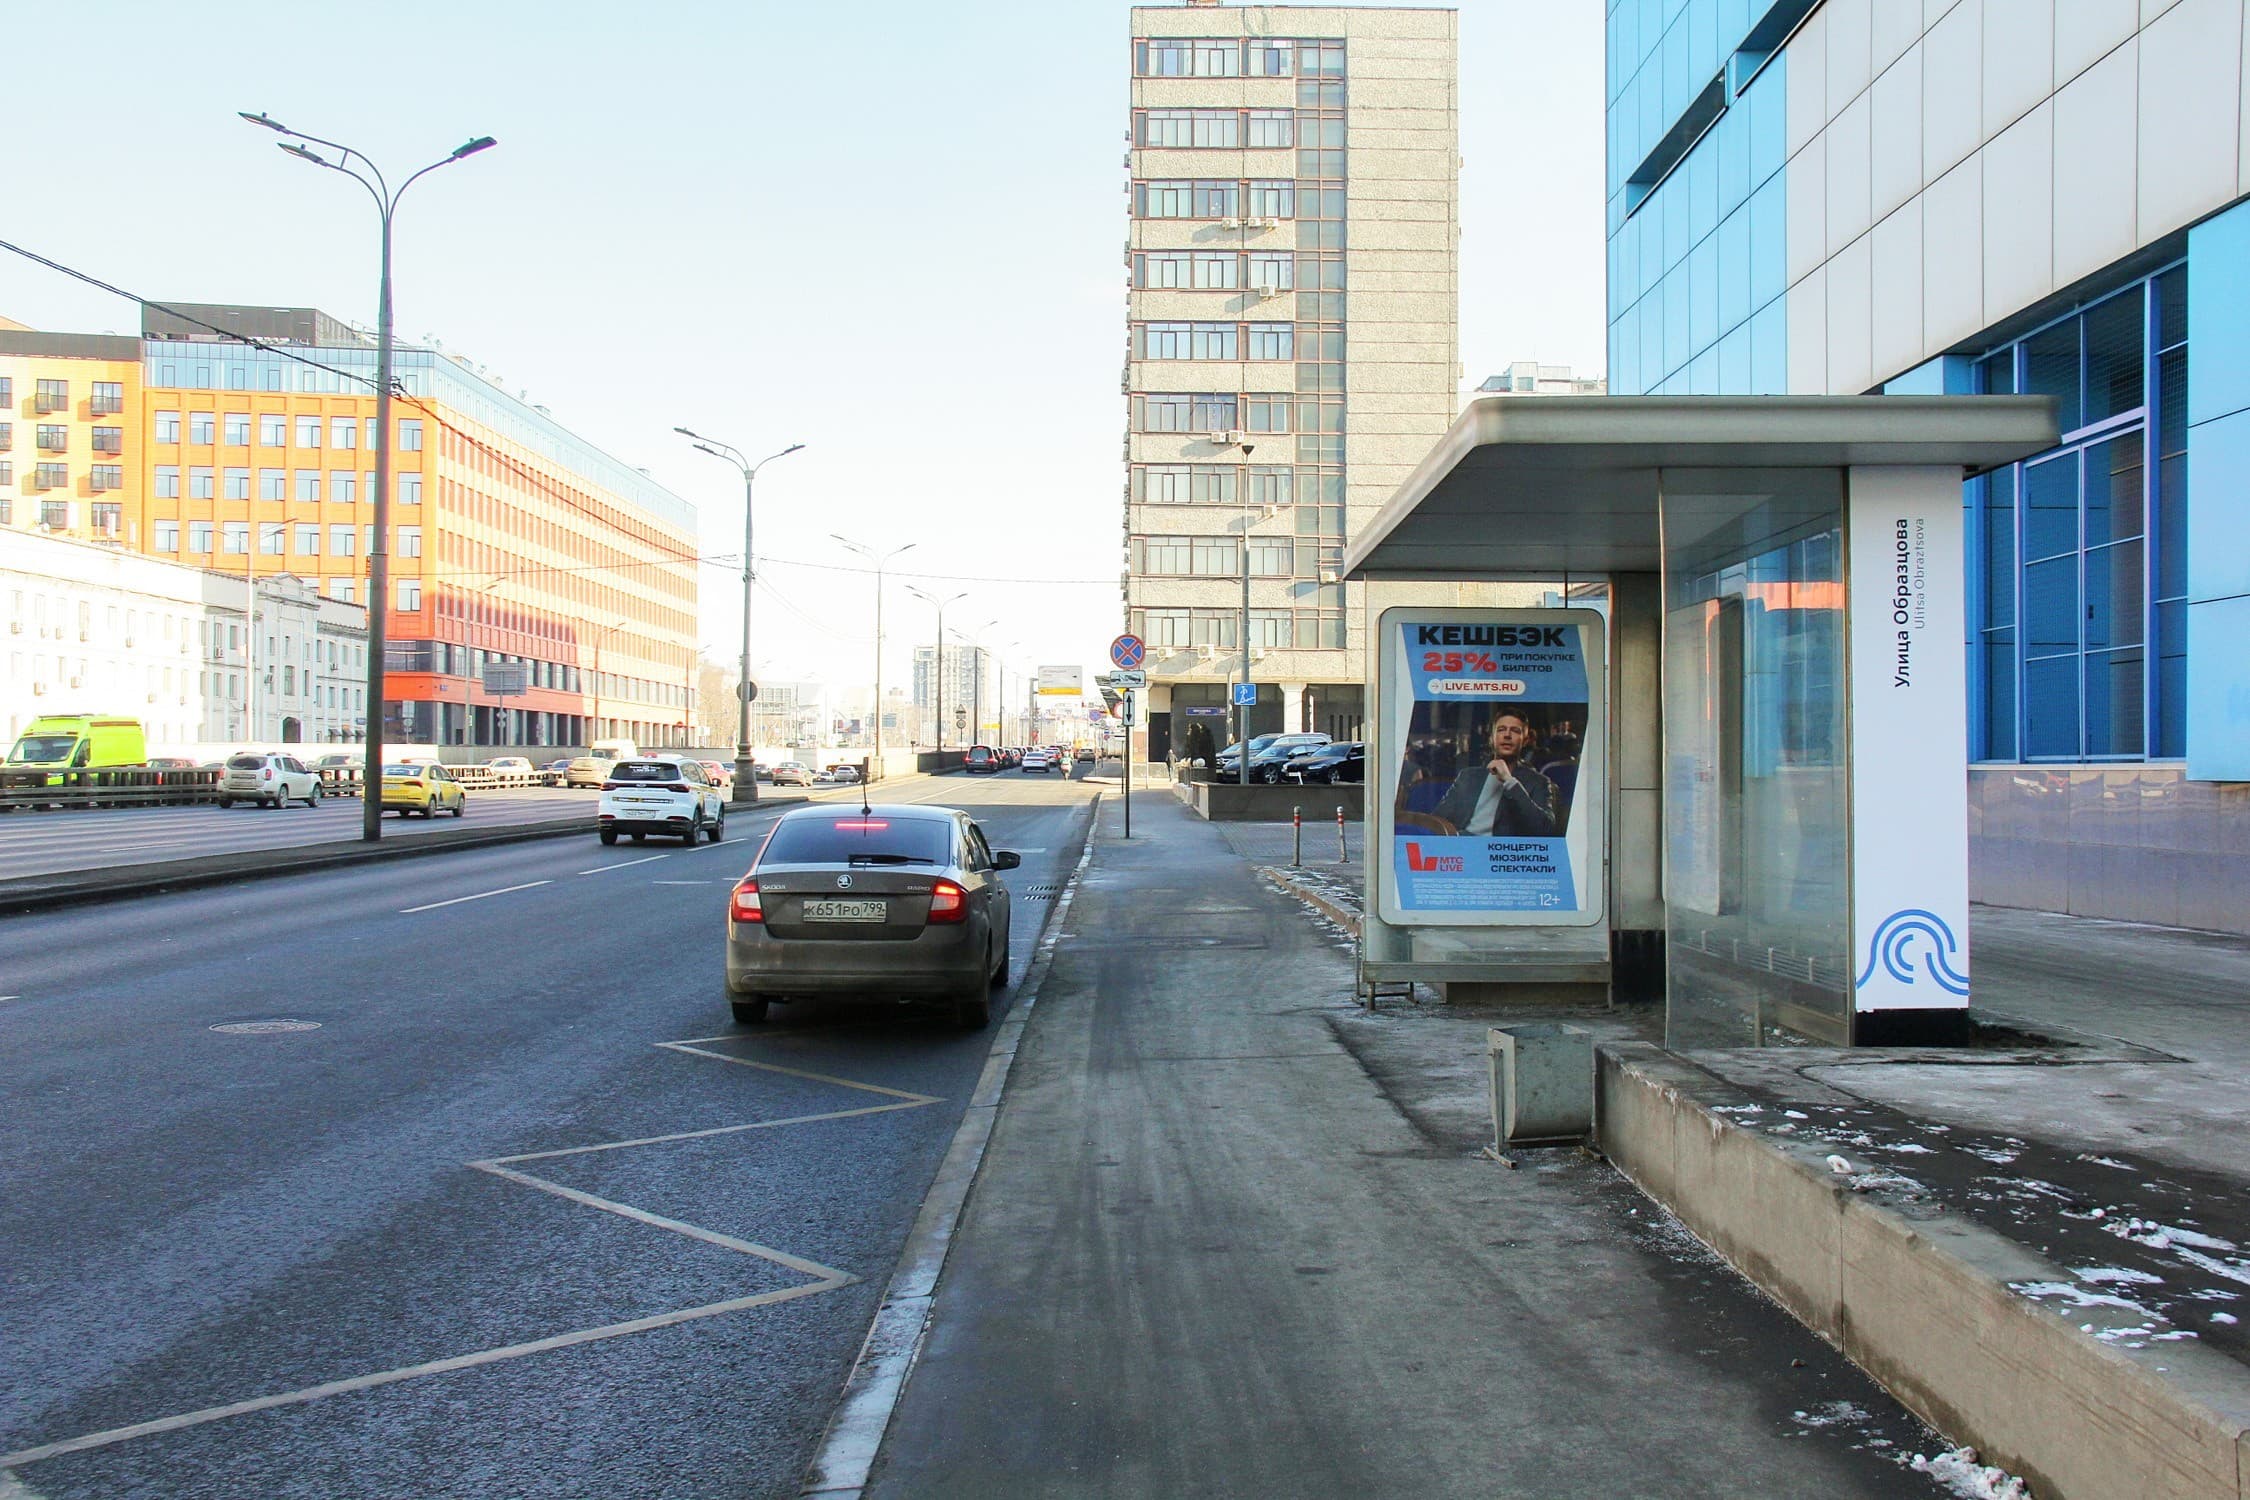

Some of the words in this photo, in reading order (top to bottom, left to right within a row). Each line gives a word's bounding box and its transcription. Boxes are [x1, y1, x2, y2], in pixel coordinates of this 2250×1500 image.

[1914, 518, 1925, 590] Obraztsova
[1893, 518, 1912, 625] Образцова
[1914, 593, 1925, 629] Ulitsa
[1418, 625, 1566, 647] КЕШБЭК
[1501, 653, 1523, 661] ПРИ
[1525, 653, 1575, 662] ПОКУПКЕ
[1895, 631, 1911, 687] Улица
[1423, 652, 1498, 673] 25%
[1502, 664, 1553, 673] БИЛЕТОВ
[1445, 683, 1519, 692] LIVE.MTS.RU
[1488, 843, 1549, 852] КОНЦЕРТЫ
[1439, 856, 1464, 864] МТС
[1489, 854, 1549, 862] МЮЗИКЛЫ
[1439, 864, 1464, 872] LIVE
[1491, 865, 1556, 873] СПЕКТАКЛИ
[1539, 893, 1561, 906] 12+
